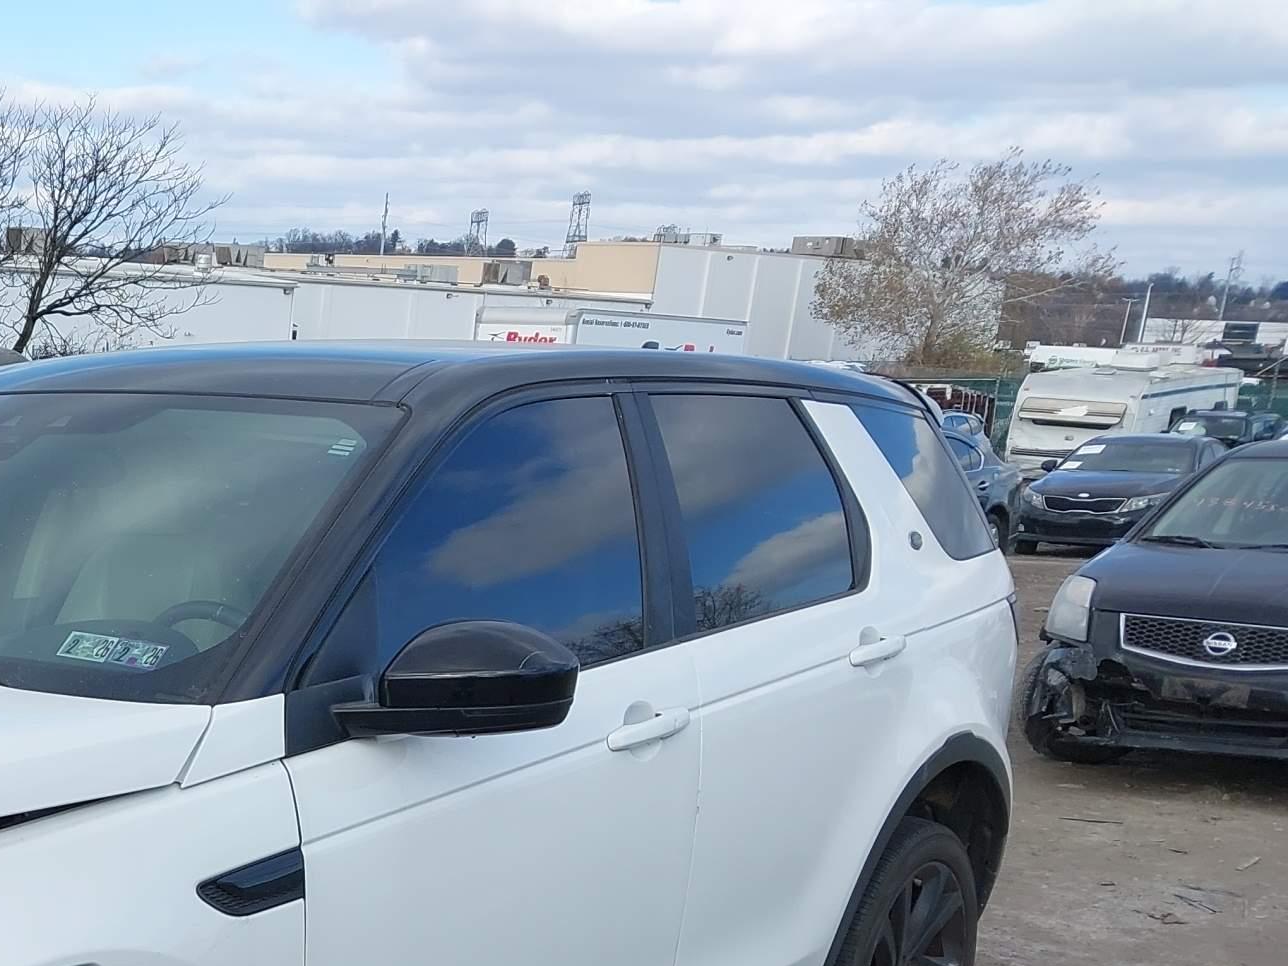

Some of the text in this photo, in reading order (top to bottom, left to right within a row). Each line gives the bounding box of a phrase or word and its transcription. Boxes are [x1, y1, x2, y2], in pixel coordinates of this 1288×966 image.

[66, 638, 114, 658] 2 26
[113, 646, 130, 662] 2
